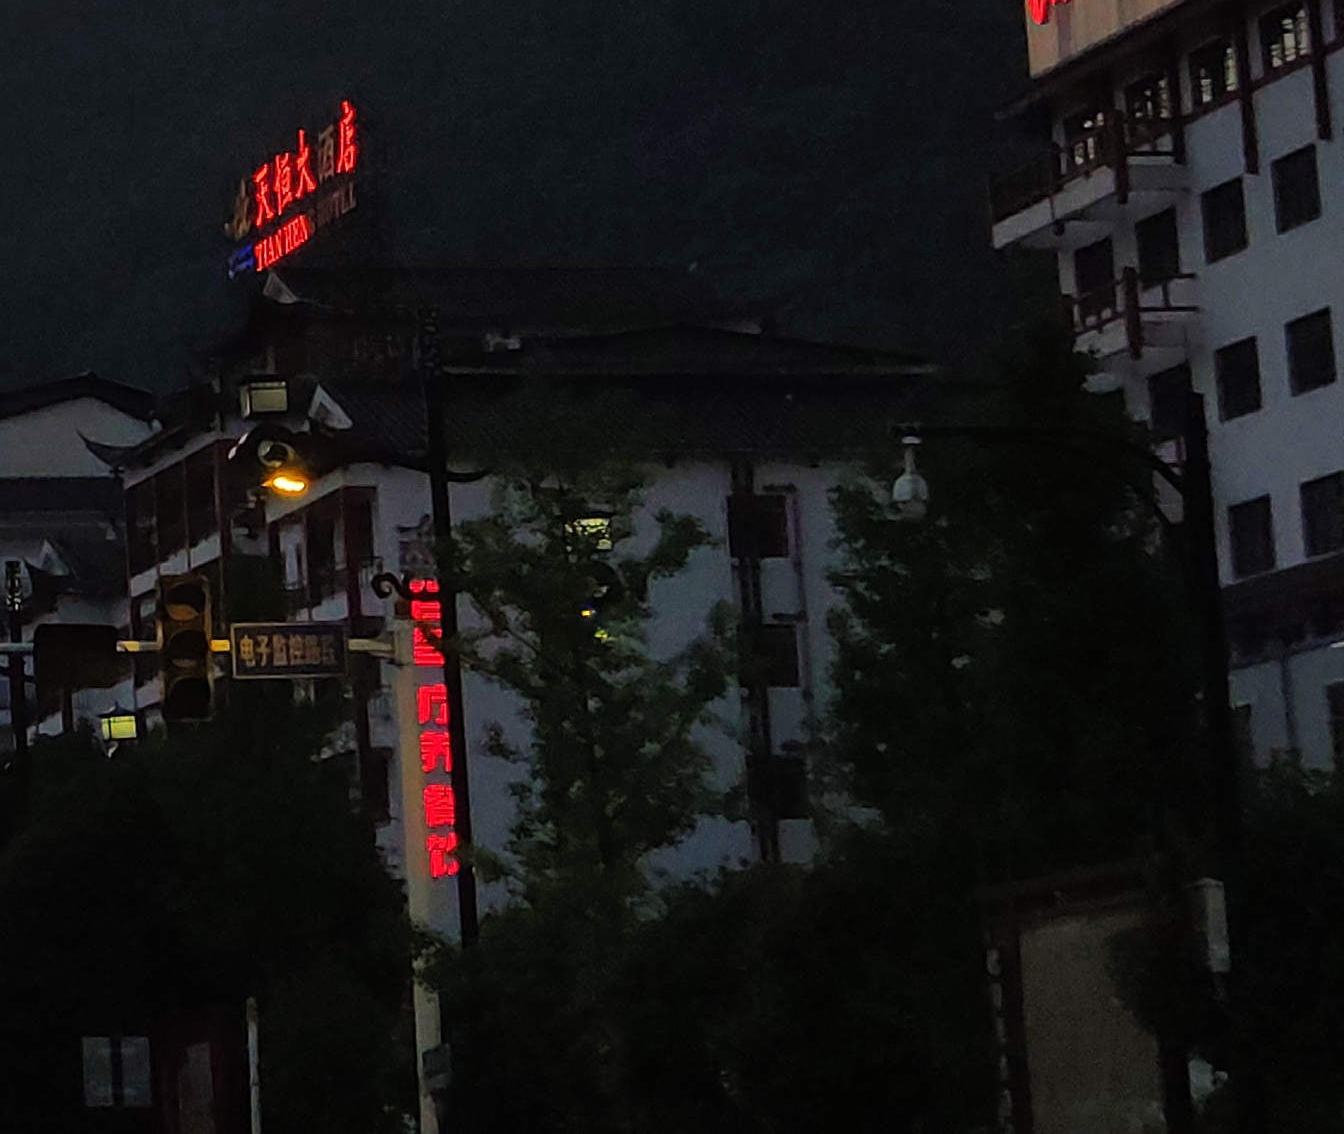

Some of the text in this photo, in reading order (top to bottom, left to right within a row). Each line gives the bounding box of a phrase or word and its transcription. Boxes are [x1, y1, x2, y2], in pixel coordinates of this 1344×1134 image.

[252, 99, 358, 228] 天恒大酒店
